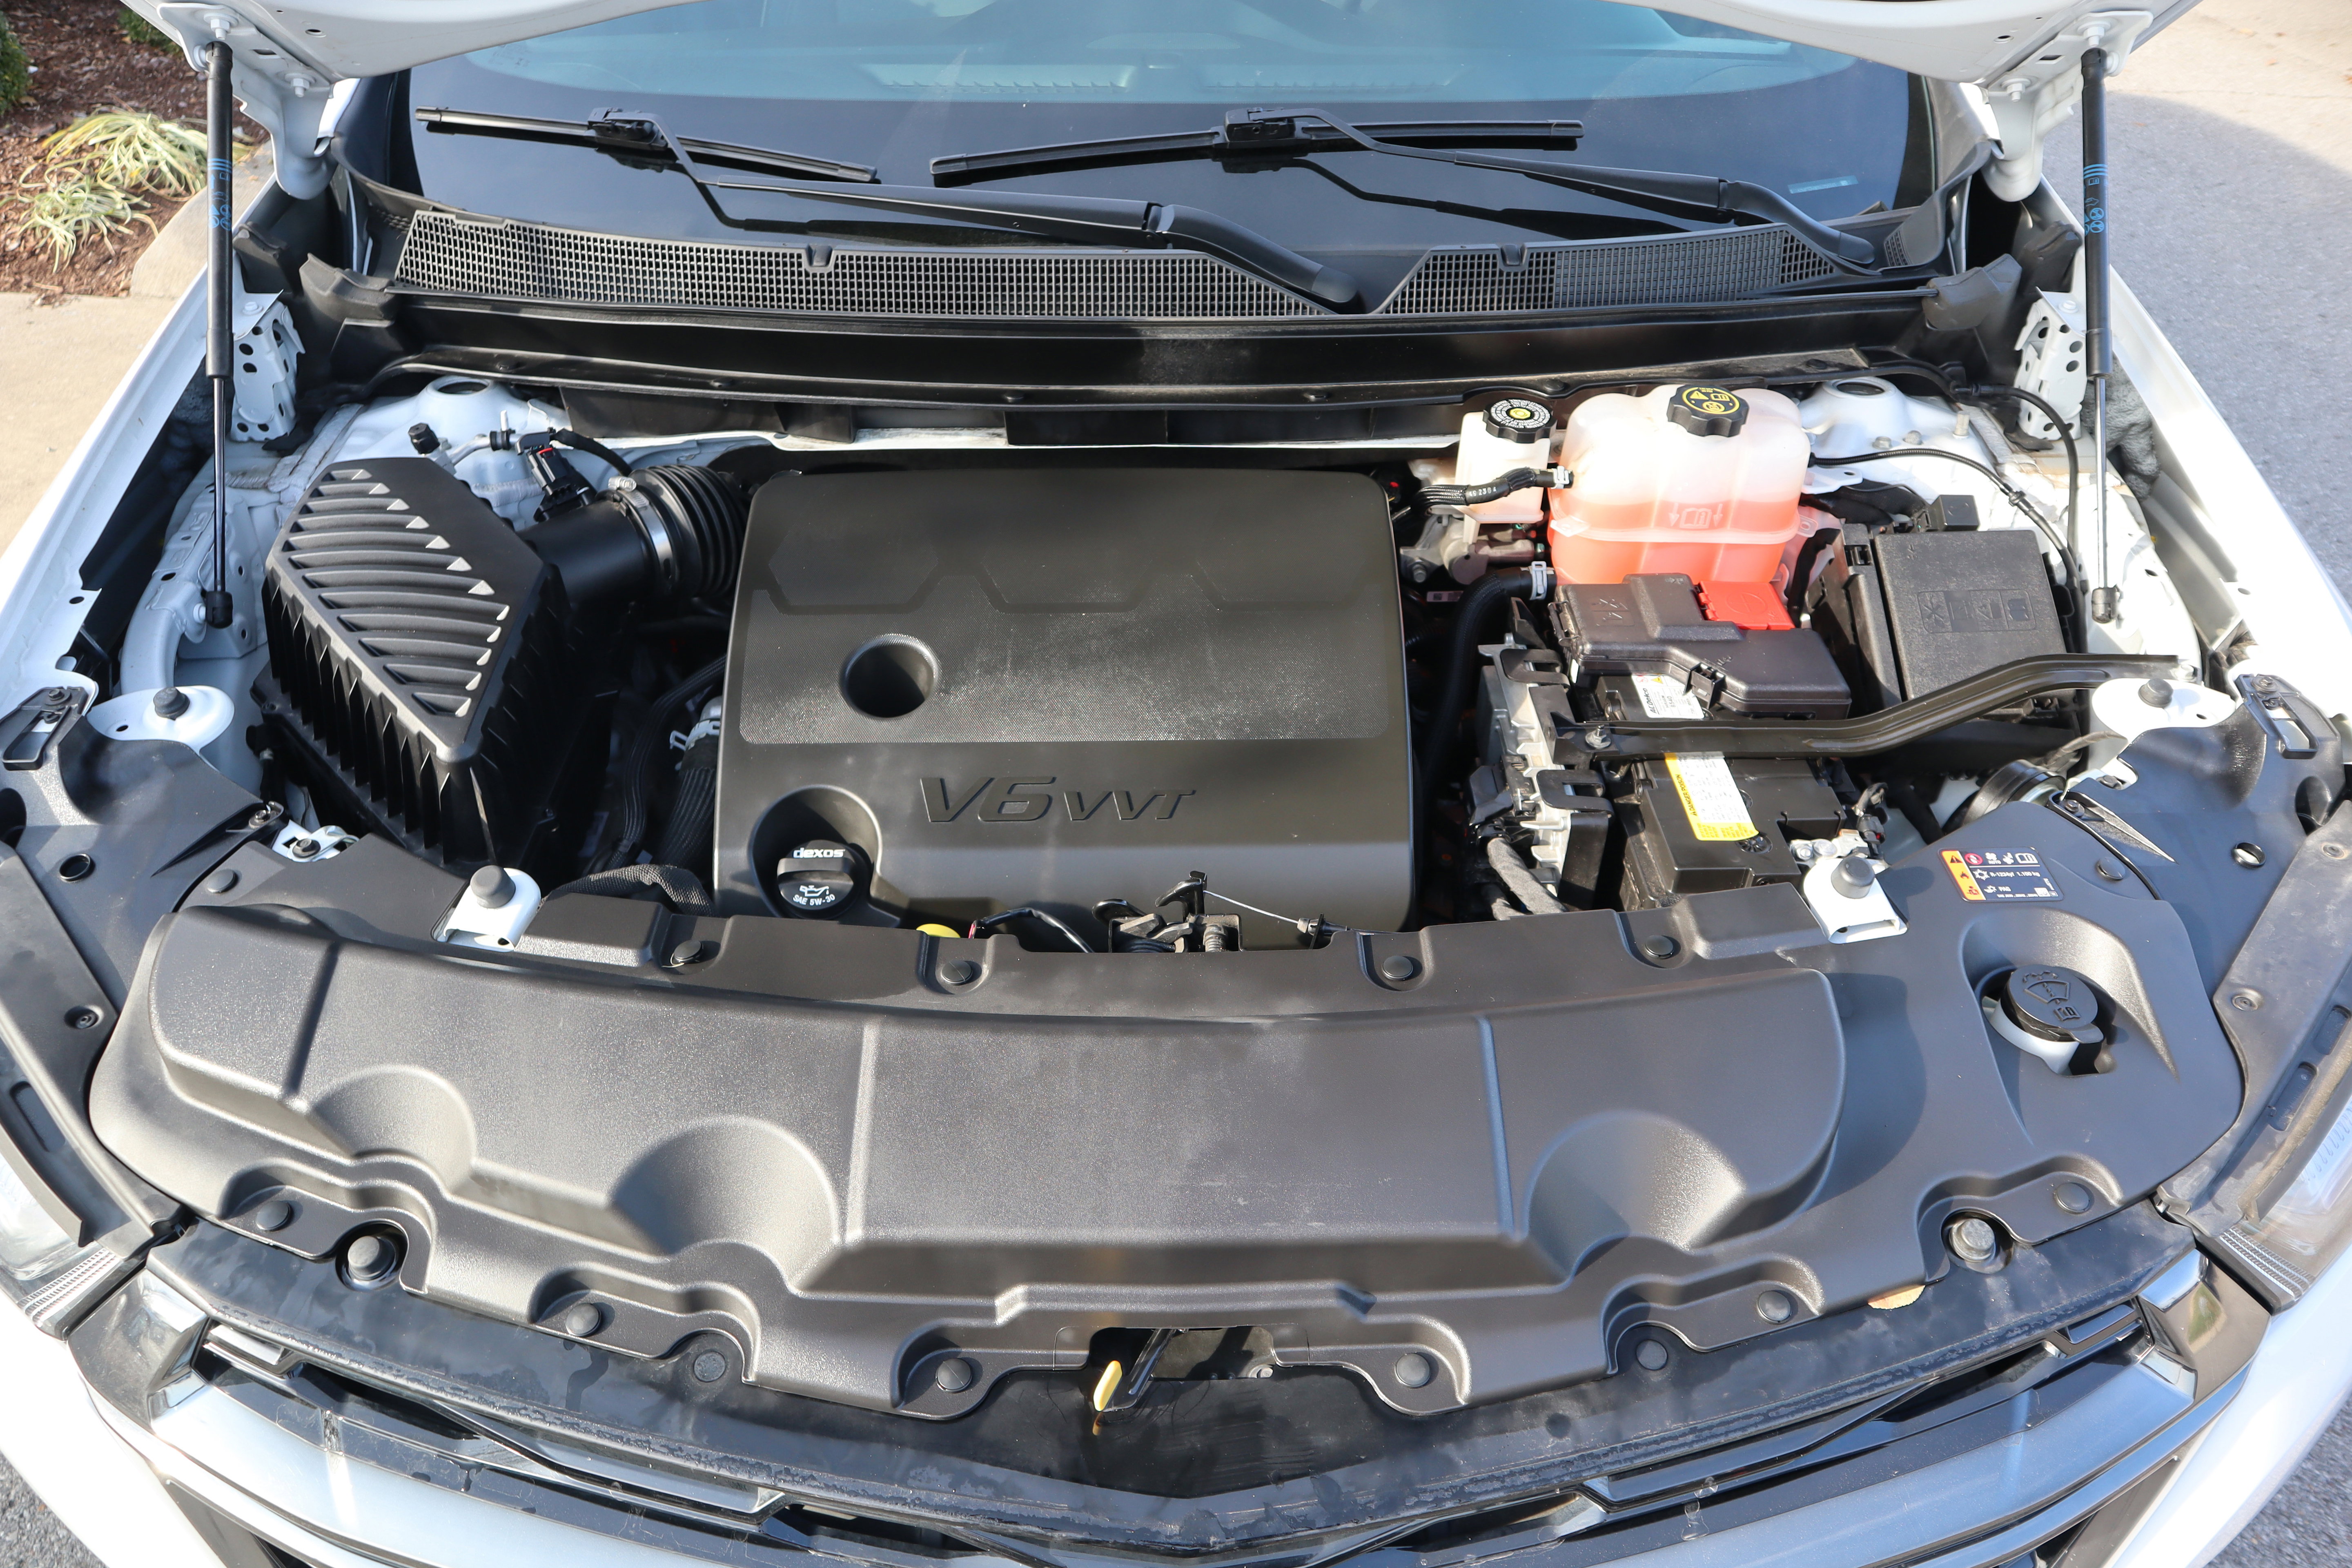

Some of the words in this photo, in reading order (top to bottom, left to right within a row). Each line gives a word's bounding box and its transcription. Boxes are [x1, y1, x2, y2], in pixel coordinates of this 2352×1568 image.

[1643, 688, 1657, 713] ACDelco
[1676, 774, 1685, 791] POISON
[920, 776, 1056, 822] V6
[1063, 790, 1196, 821] VVT
[1684, 793, 1695, 811] DANGER
[793, 847, 844, 858] dexos
[793, 894, 808, 905] SAE
[810, 894, 835, 905] 5W-30
